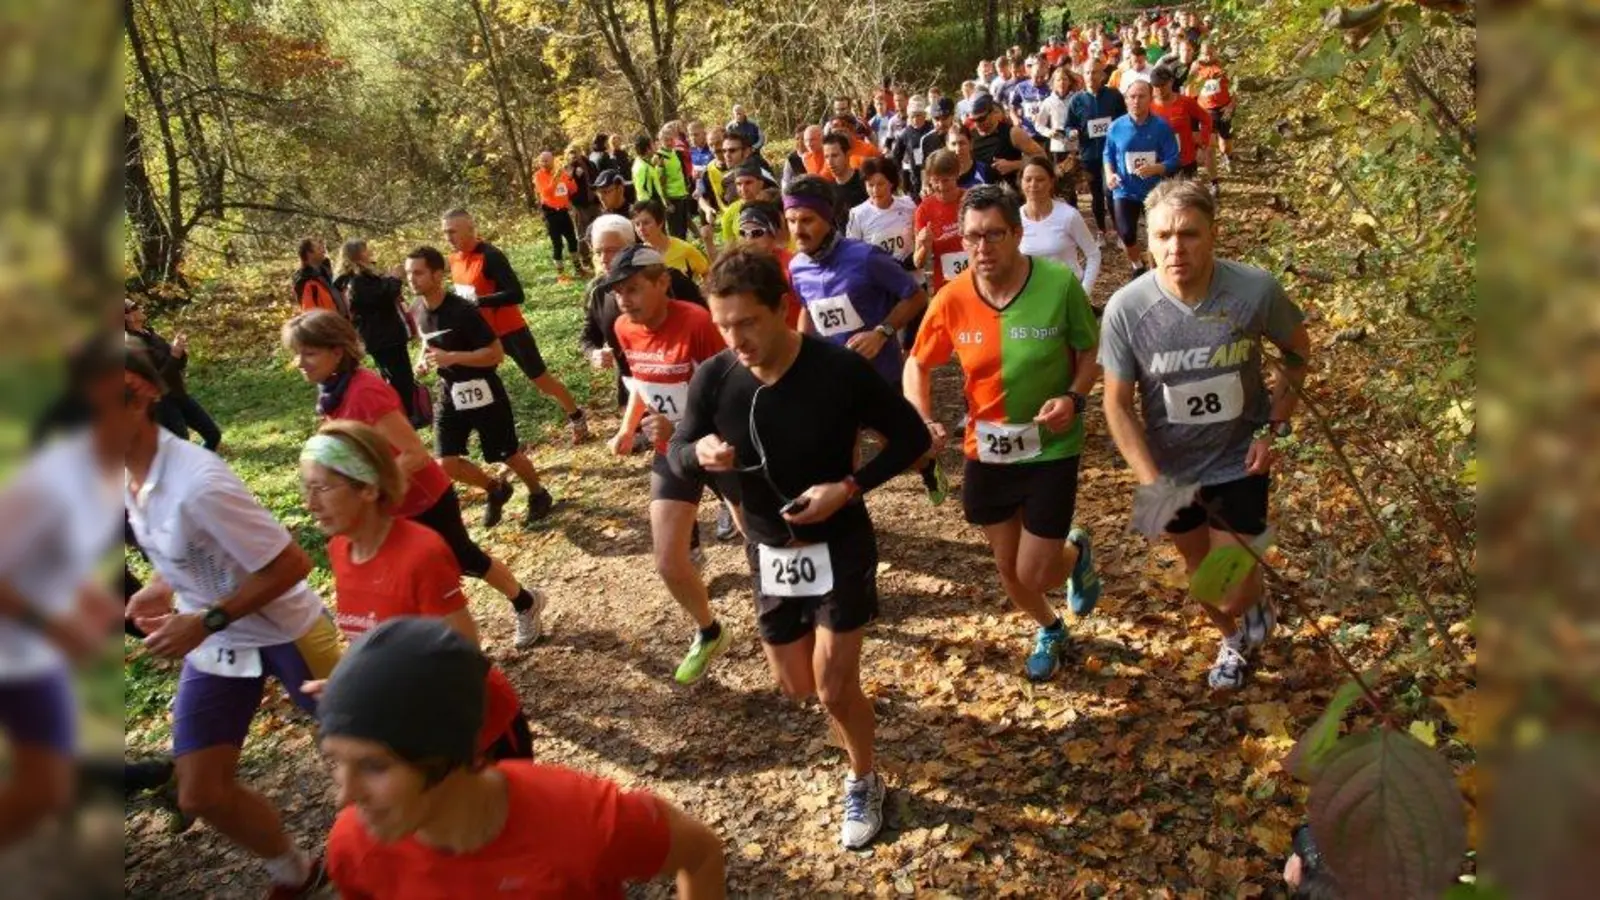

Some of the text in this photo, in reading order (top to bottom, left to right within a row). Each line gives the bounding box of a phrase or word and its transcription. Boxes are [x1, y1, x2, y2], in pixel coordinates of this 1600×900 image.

[880, 235, 904, 251] 370
[819, 308, 848, 328] 257
[457, 388, 484, 404] 379
[653, 394, 678, 414] 21
[1186, 392, 1222, 417] 28
[986, 434, 1024, 455] 251
[772, 556, 817, 585] 250
